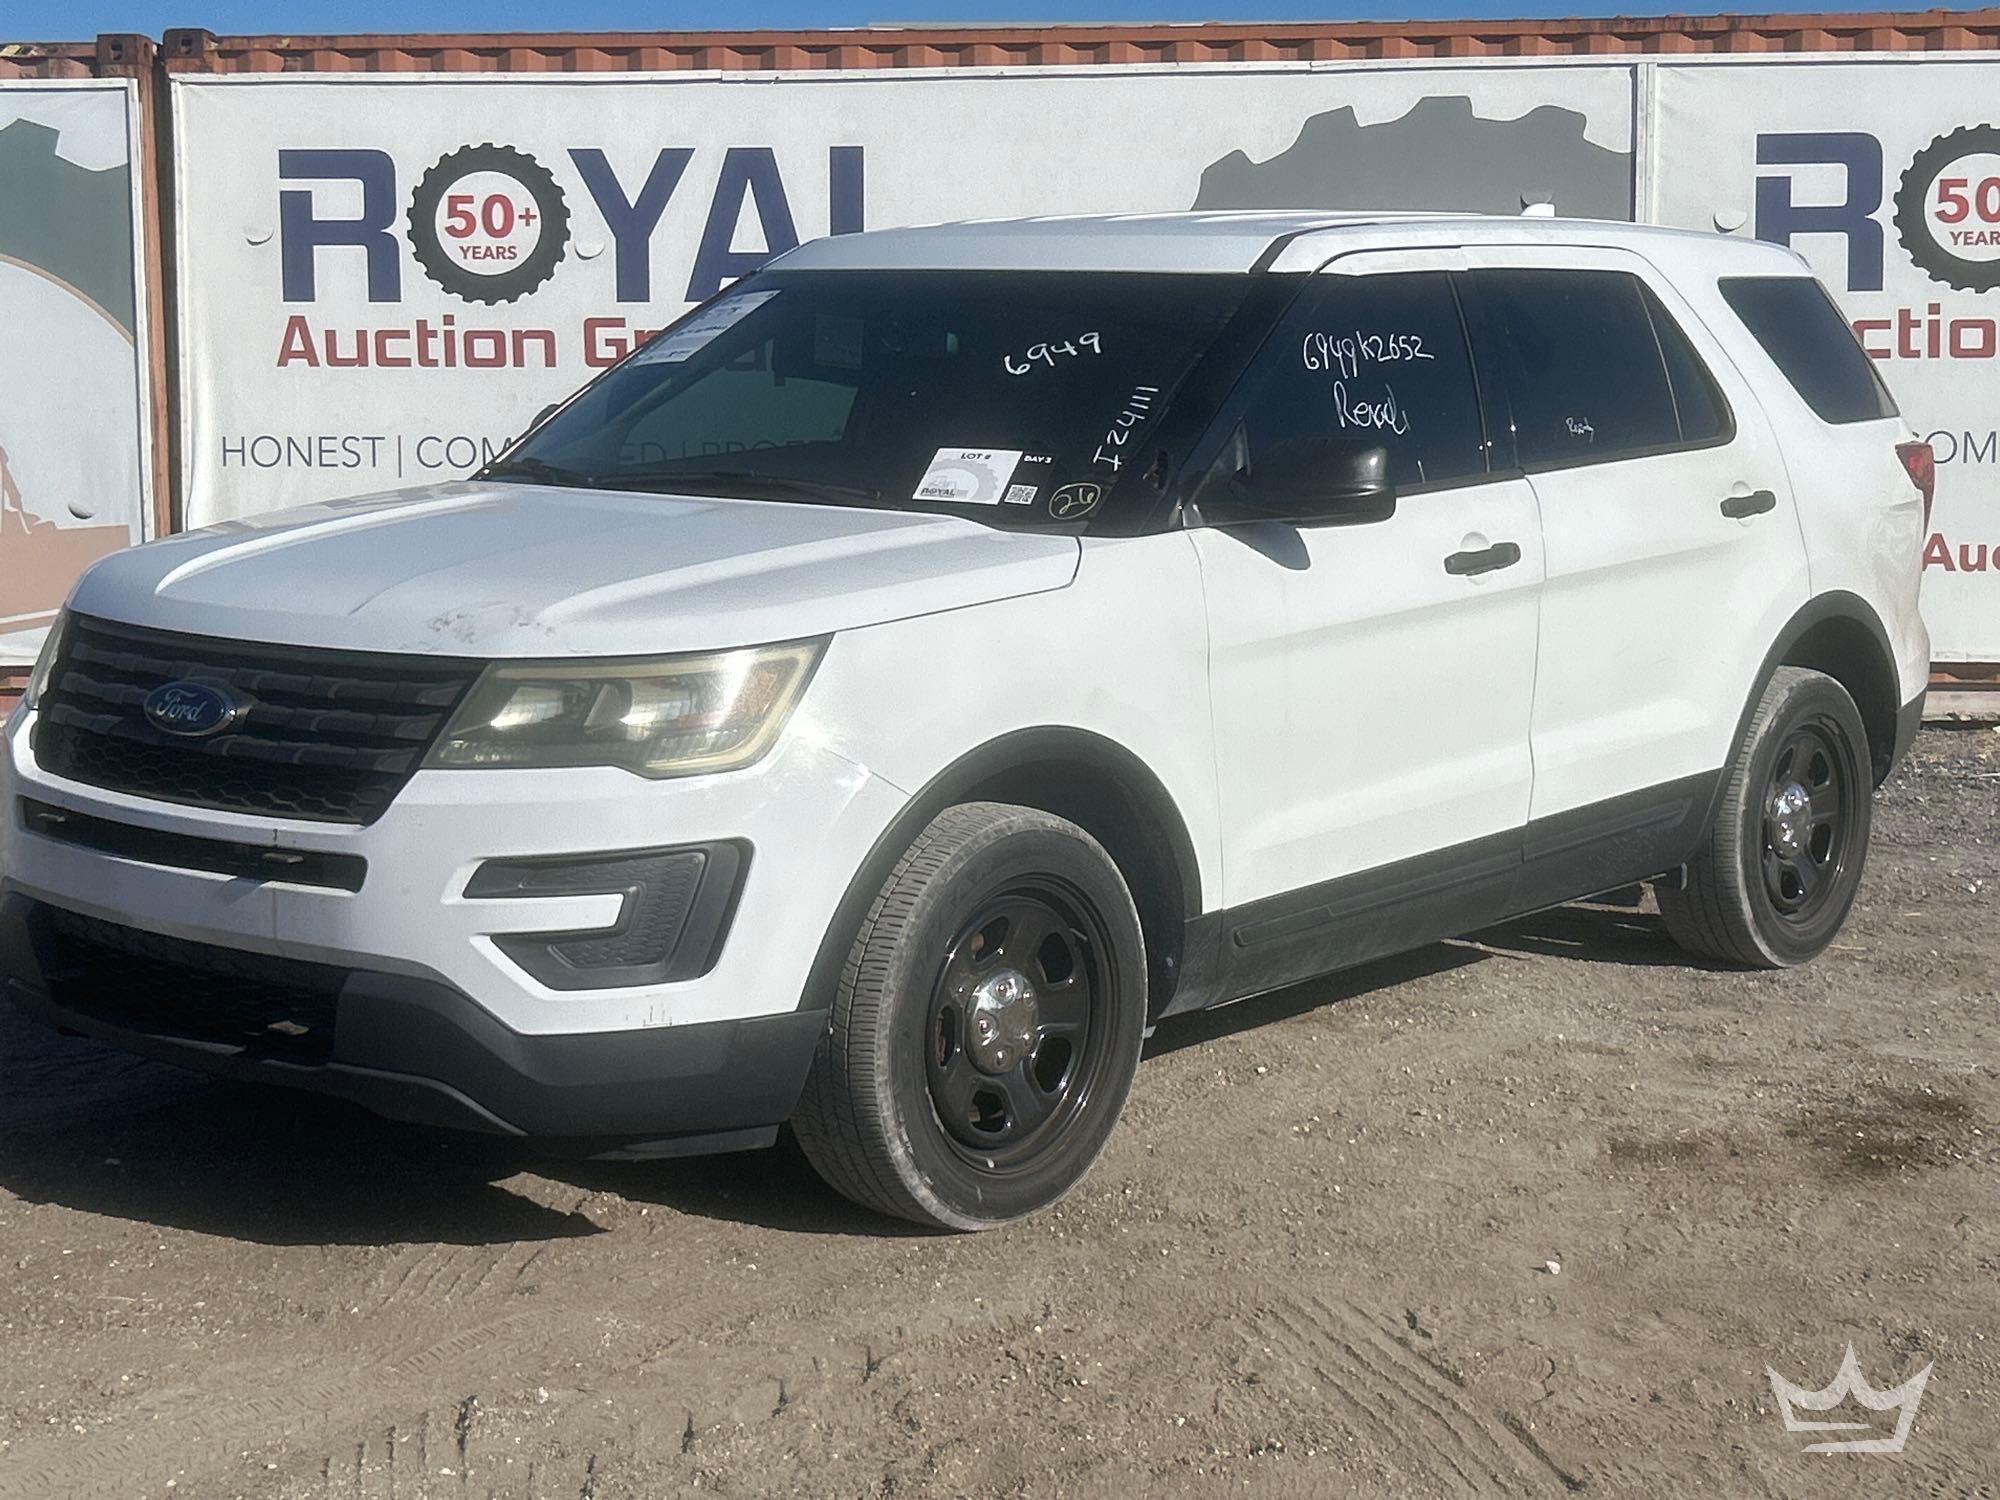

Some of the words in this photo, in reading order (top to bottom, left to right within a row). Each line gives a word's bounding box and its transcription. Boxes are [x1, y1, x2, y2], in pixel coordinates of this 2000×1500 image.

[444, 193, 538, 240] 50+
[458, 245, 518, 261] YEARS
[276, 315, 557, 368] Auction
[1003, 332, 1102, 375] 6949
[222, 436, 385, 469] HONEST
[156, 688, 209, 722] Ford
